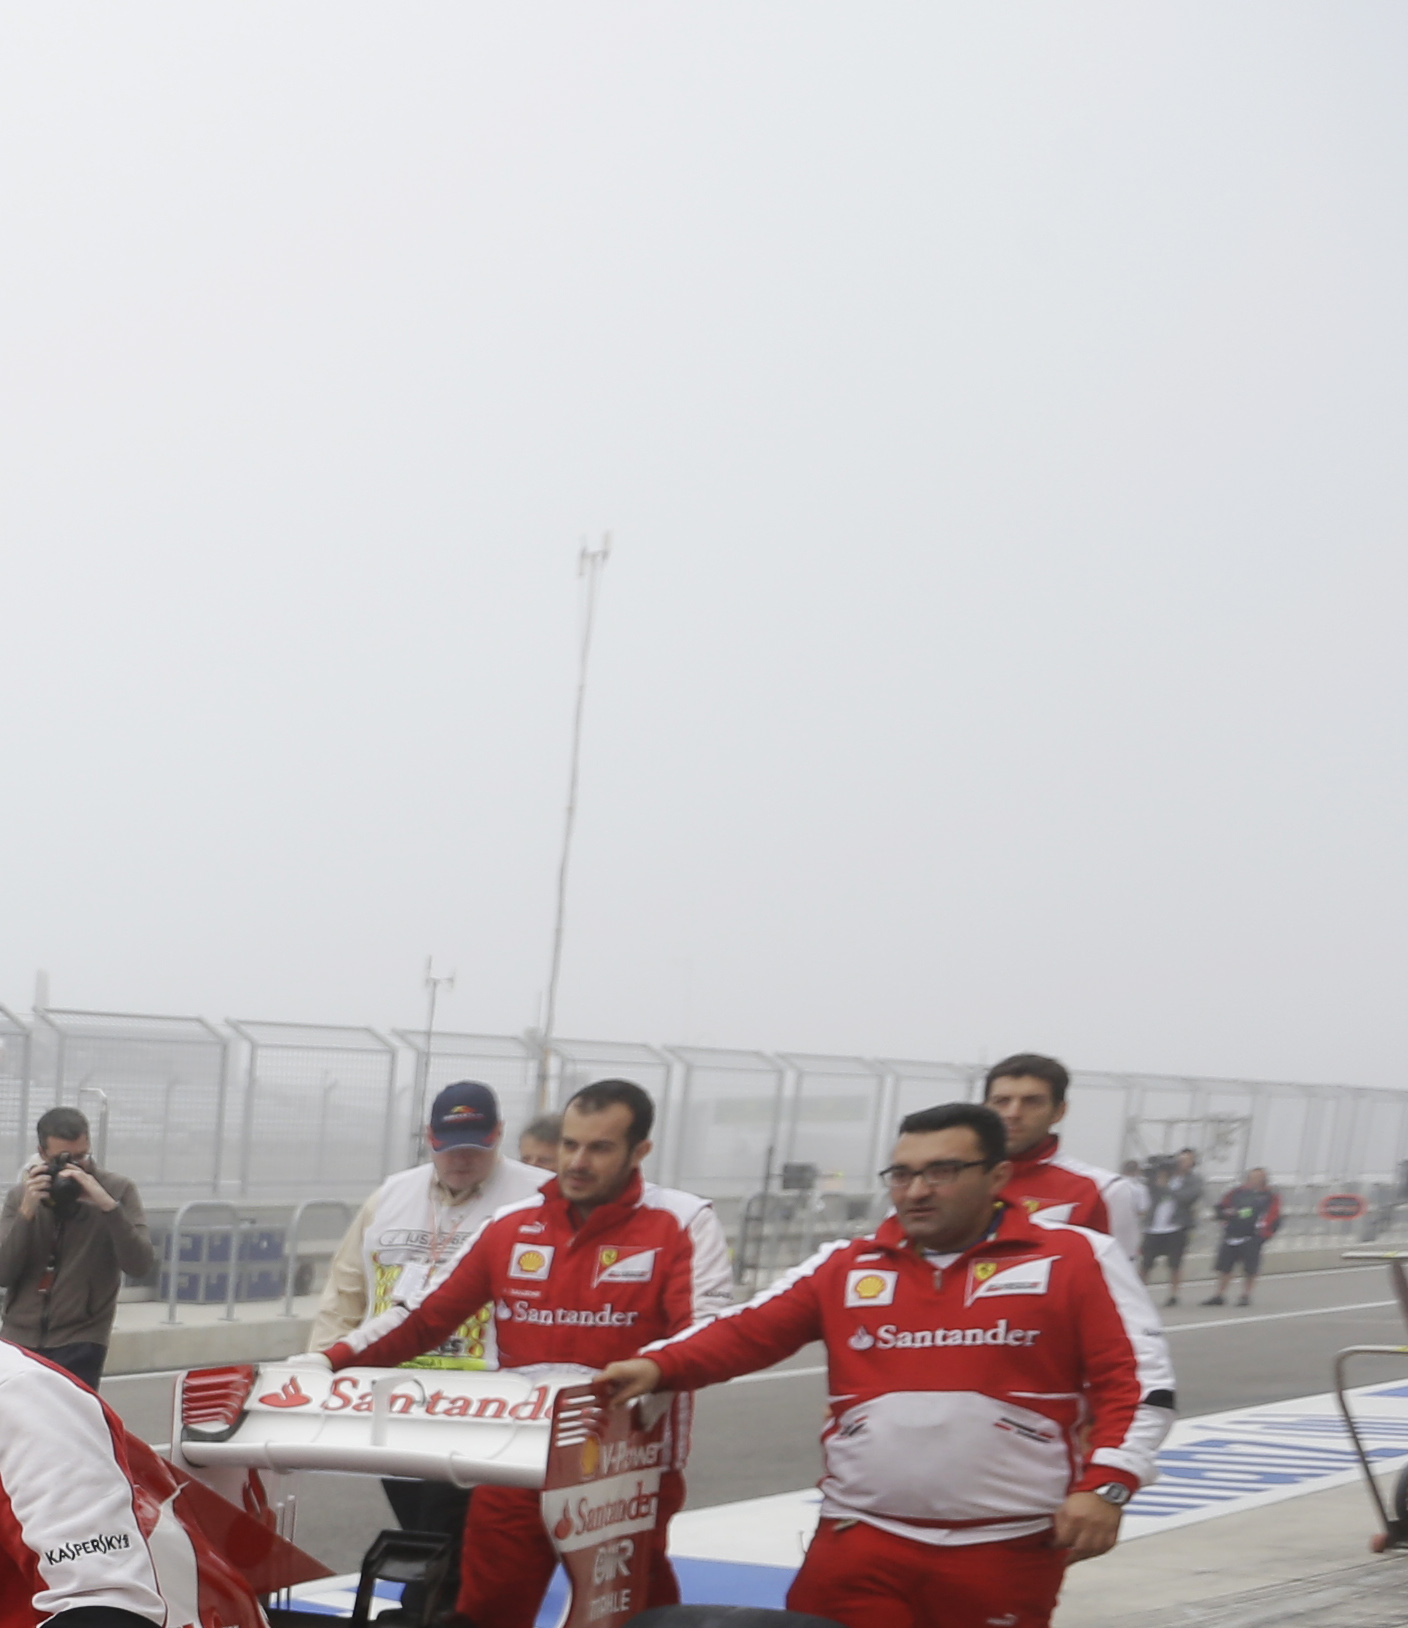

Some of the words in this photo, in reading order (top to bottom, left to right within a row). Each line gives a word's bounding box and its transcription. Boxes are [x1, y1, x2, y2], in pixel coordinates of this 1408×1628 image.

[514, 1300, 638, 1327] Santander
[876, 1319, 1040, 1350] Santander
[320, 1376, 553, 1420] Santand
[45, 1533, 123, 1566] KASPERSKY
